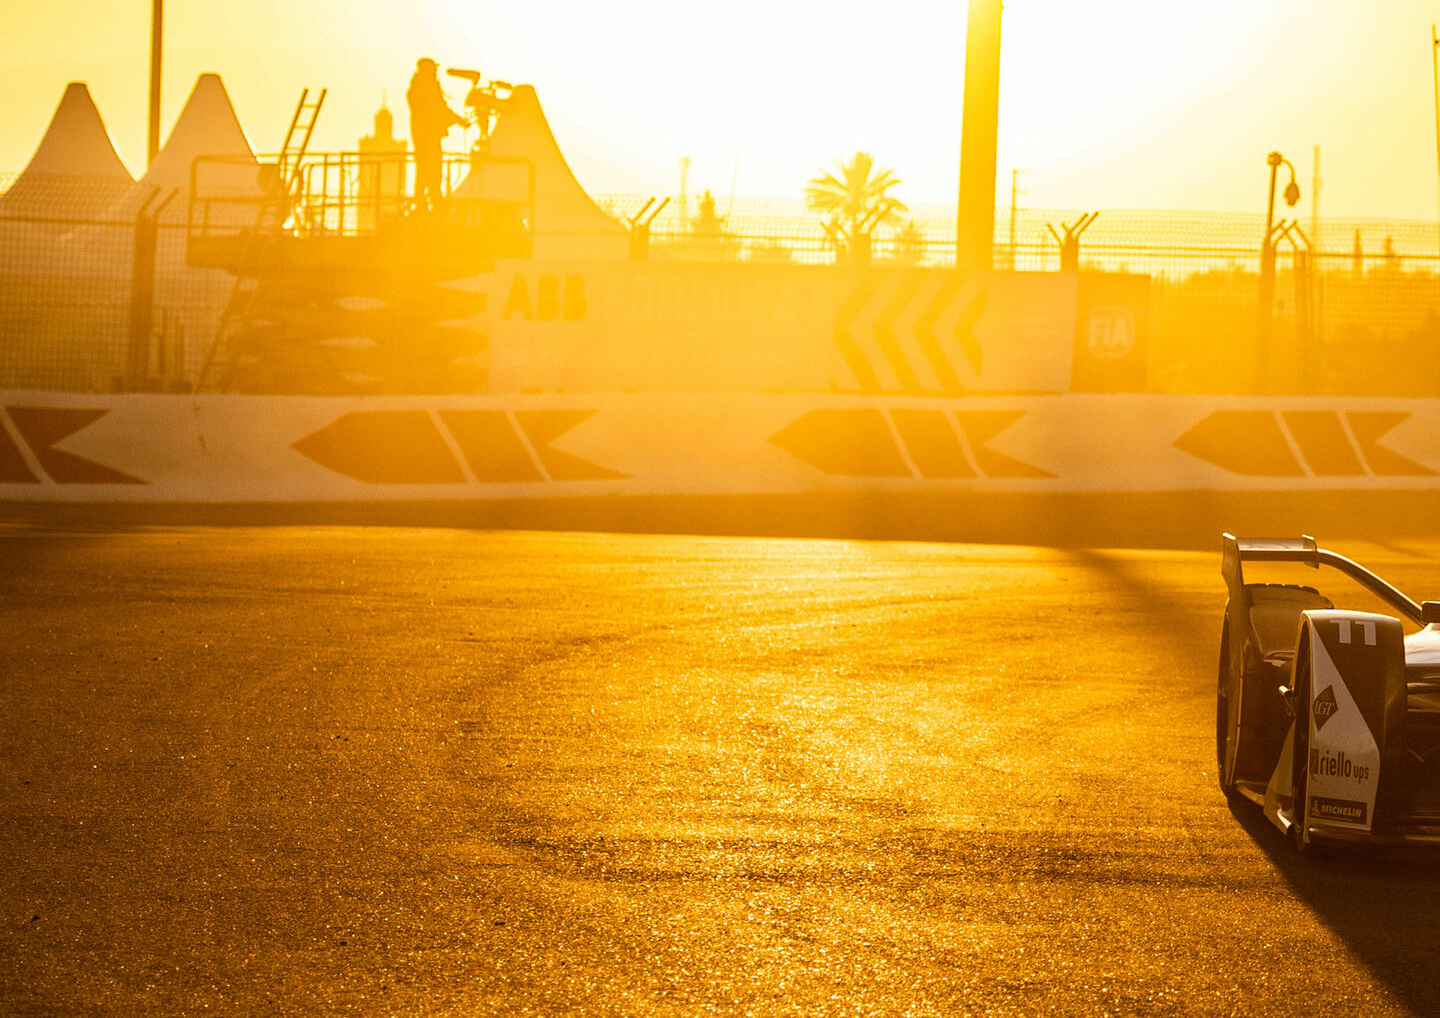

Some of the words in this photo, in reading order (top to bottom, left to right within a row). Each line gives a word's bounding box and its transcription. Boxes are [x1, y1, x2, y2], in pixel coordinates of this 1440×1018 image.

[502, 273, 588, 322] ABB
[1330, 619, 1376, 646] 11
[1315, 700, 1335, 717] LGT
[1319, 750, 1352, 777] riello
[1353, 765, 1369, 783] ups
[1321, 804, 1363, 818] MICHELIN
